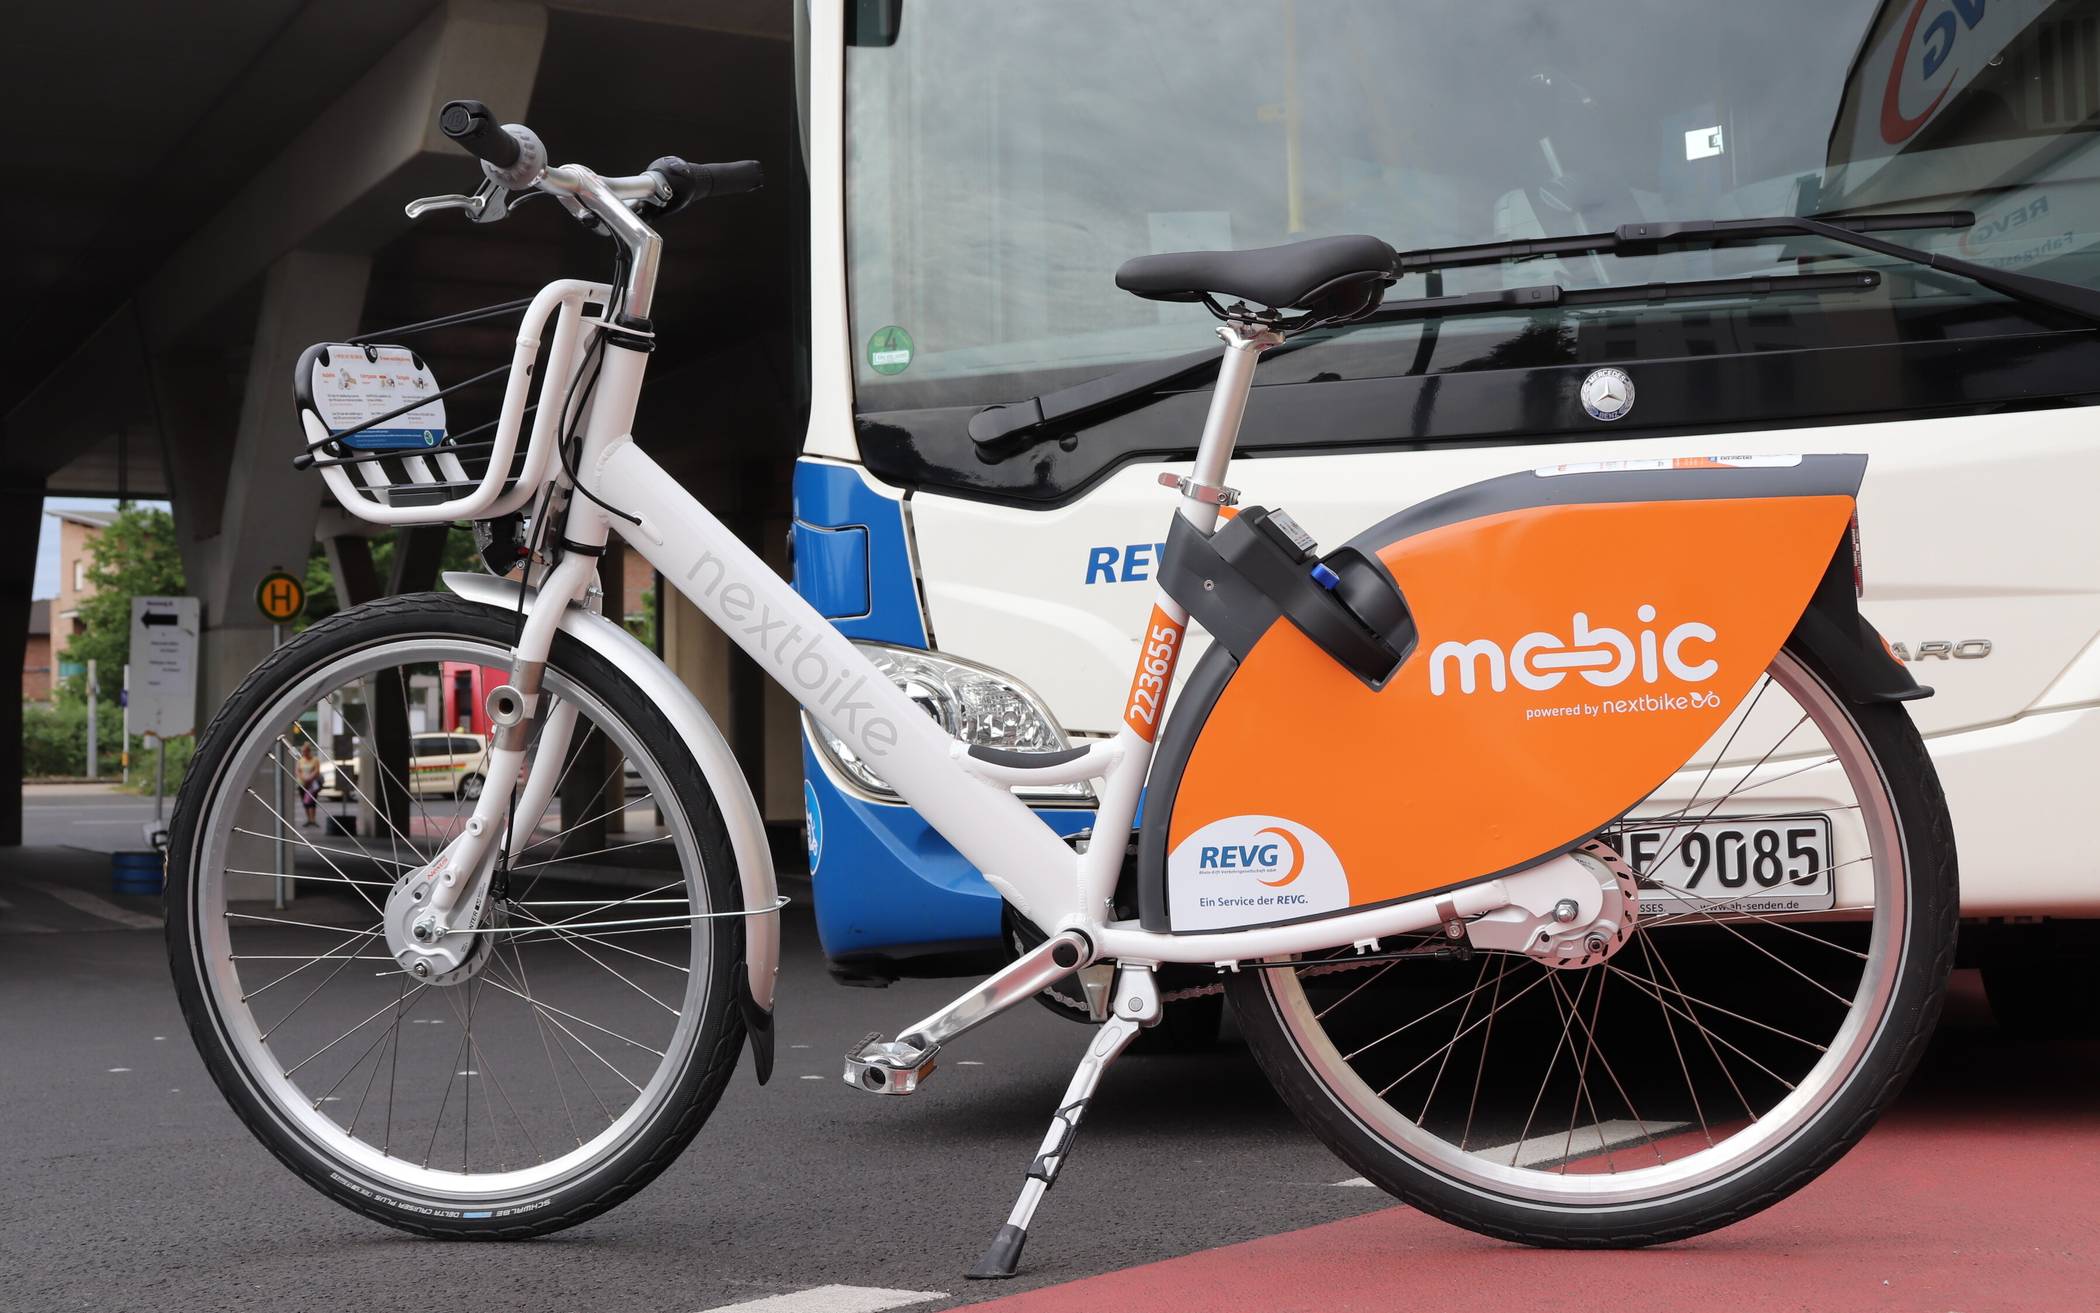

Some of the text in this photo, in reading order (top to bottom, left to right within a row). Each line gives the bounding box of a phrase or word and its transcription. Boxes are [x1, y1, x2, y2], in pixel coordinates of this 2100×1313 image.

[883, 327, 897, 351] 4
[1588, 370, 1627, 384] MERCEDES
[1085, 543, 1166, 584] RE
[270, 583, 291, 611] H
[687, 551, 897, 756] nextbike
[1429, 604, 1719, 696] mobic
[1890, 639, 1993, 662] ARO
[1129, 625, 1178, 725] 223655
[1526, 692, 1688, 720] powered by nextbike
[1199, 844, 1278, 868] REVG
[1681, 828, 1819, 889] 9085
[1199, 895, 1309, 907] Ein Service der REVG.
[468, 910, 479, 930] NTER
[374, 1194, 551, 1219] SCHWALBE DELTA CRUISER PLUS
